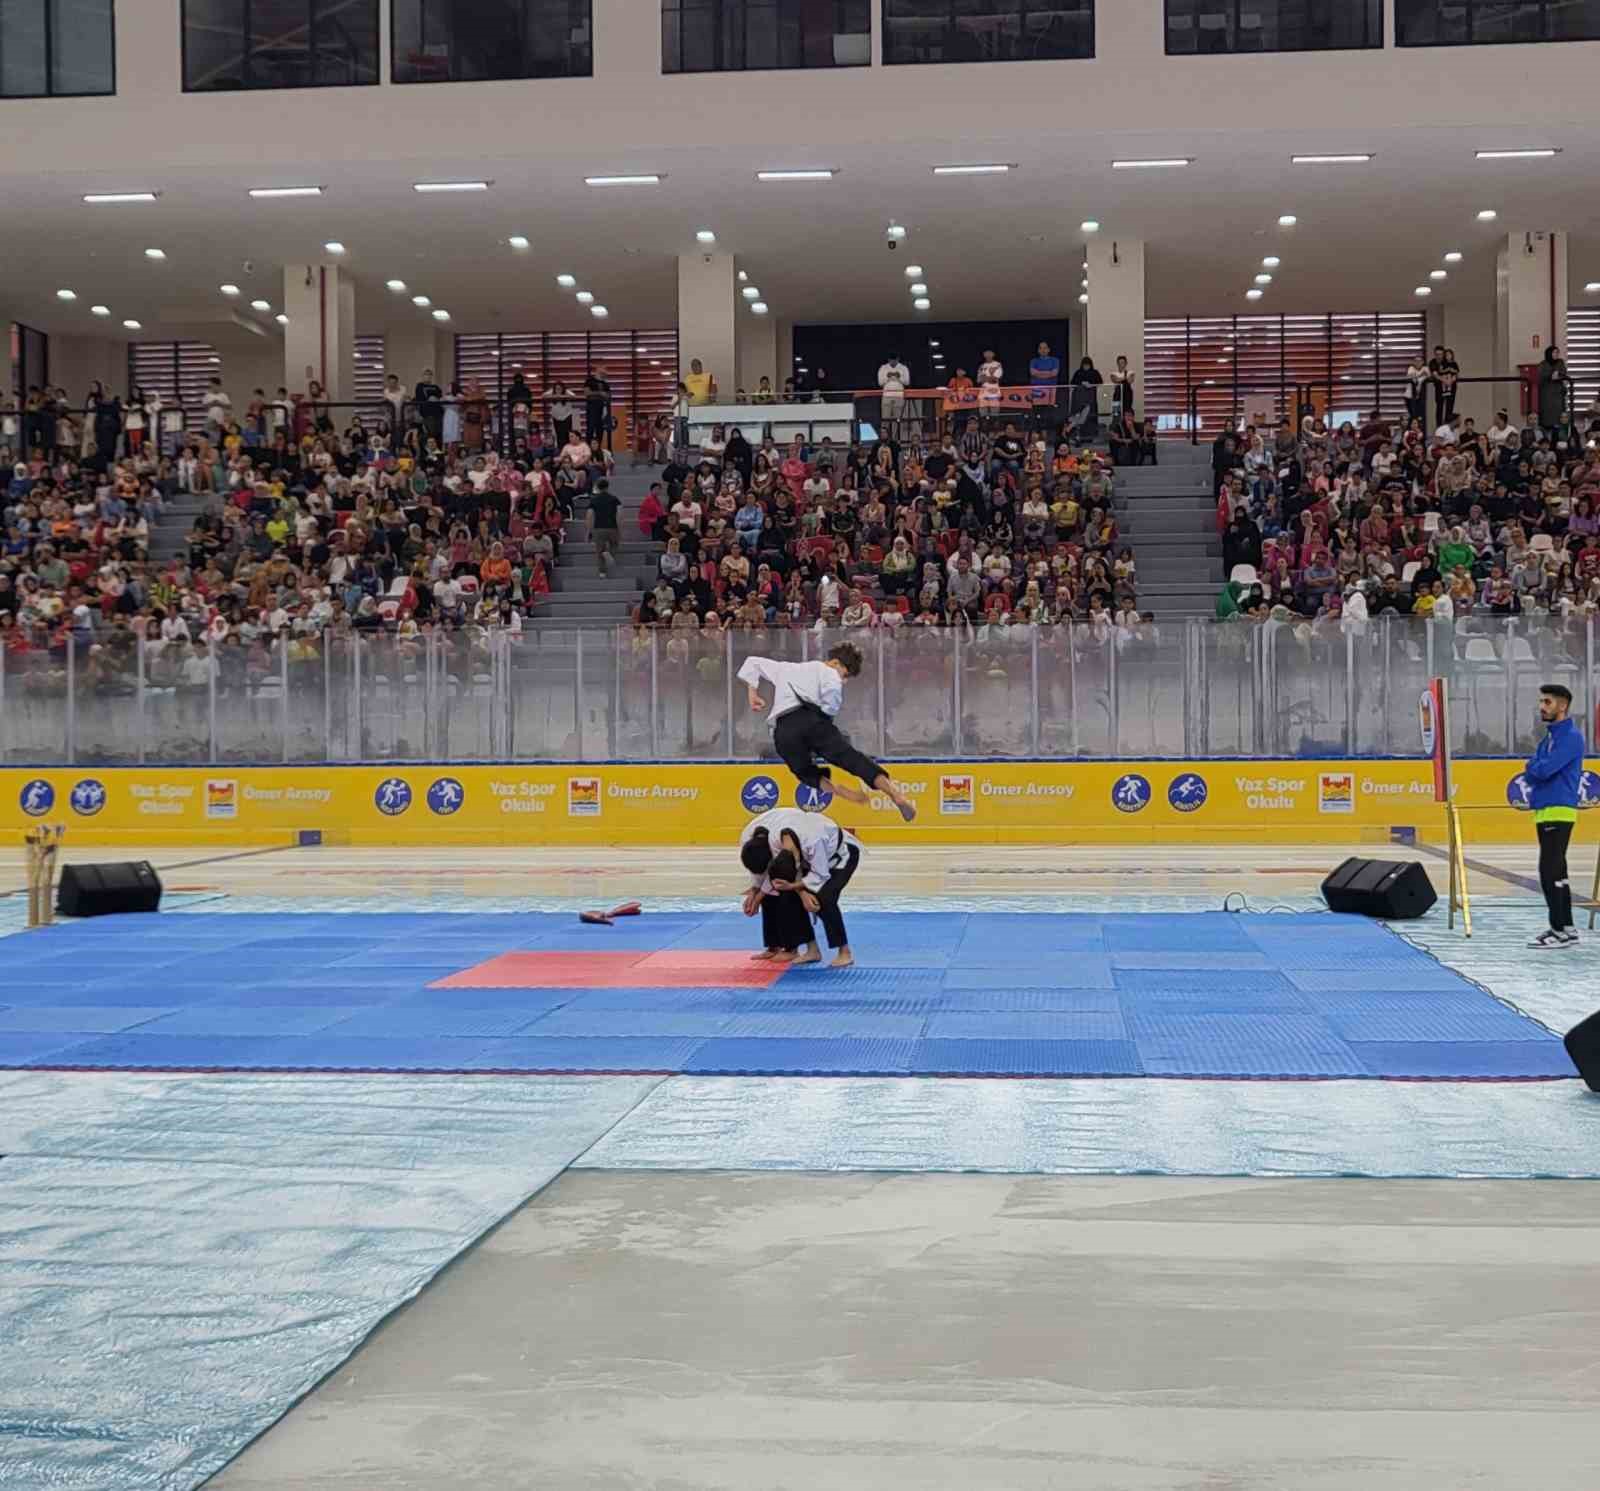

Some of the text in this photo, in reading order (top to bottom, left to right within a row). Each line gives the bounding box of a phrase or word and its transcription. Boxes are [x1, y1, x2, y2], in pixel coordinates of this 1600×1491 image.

[490, 781, 556, 798] Yaz Spor
[608, 782, 649, 798] Ömer
[980, 780, 1074, 798] Ömer Arısoy
[1235, 777, 1306, 794] Yaz Spor
[1361, 777, 1405, 793] Ömer
[501, 799, 545, 813] Okulu
[1247, 795, 1295, 809] Okulu
